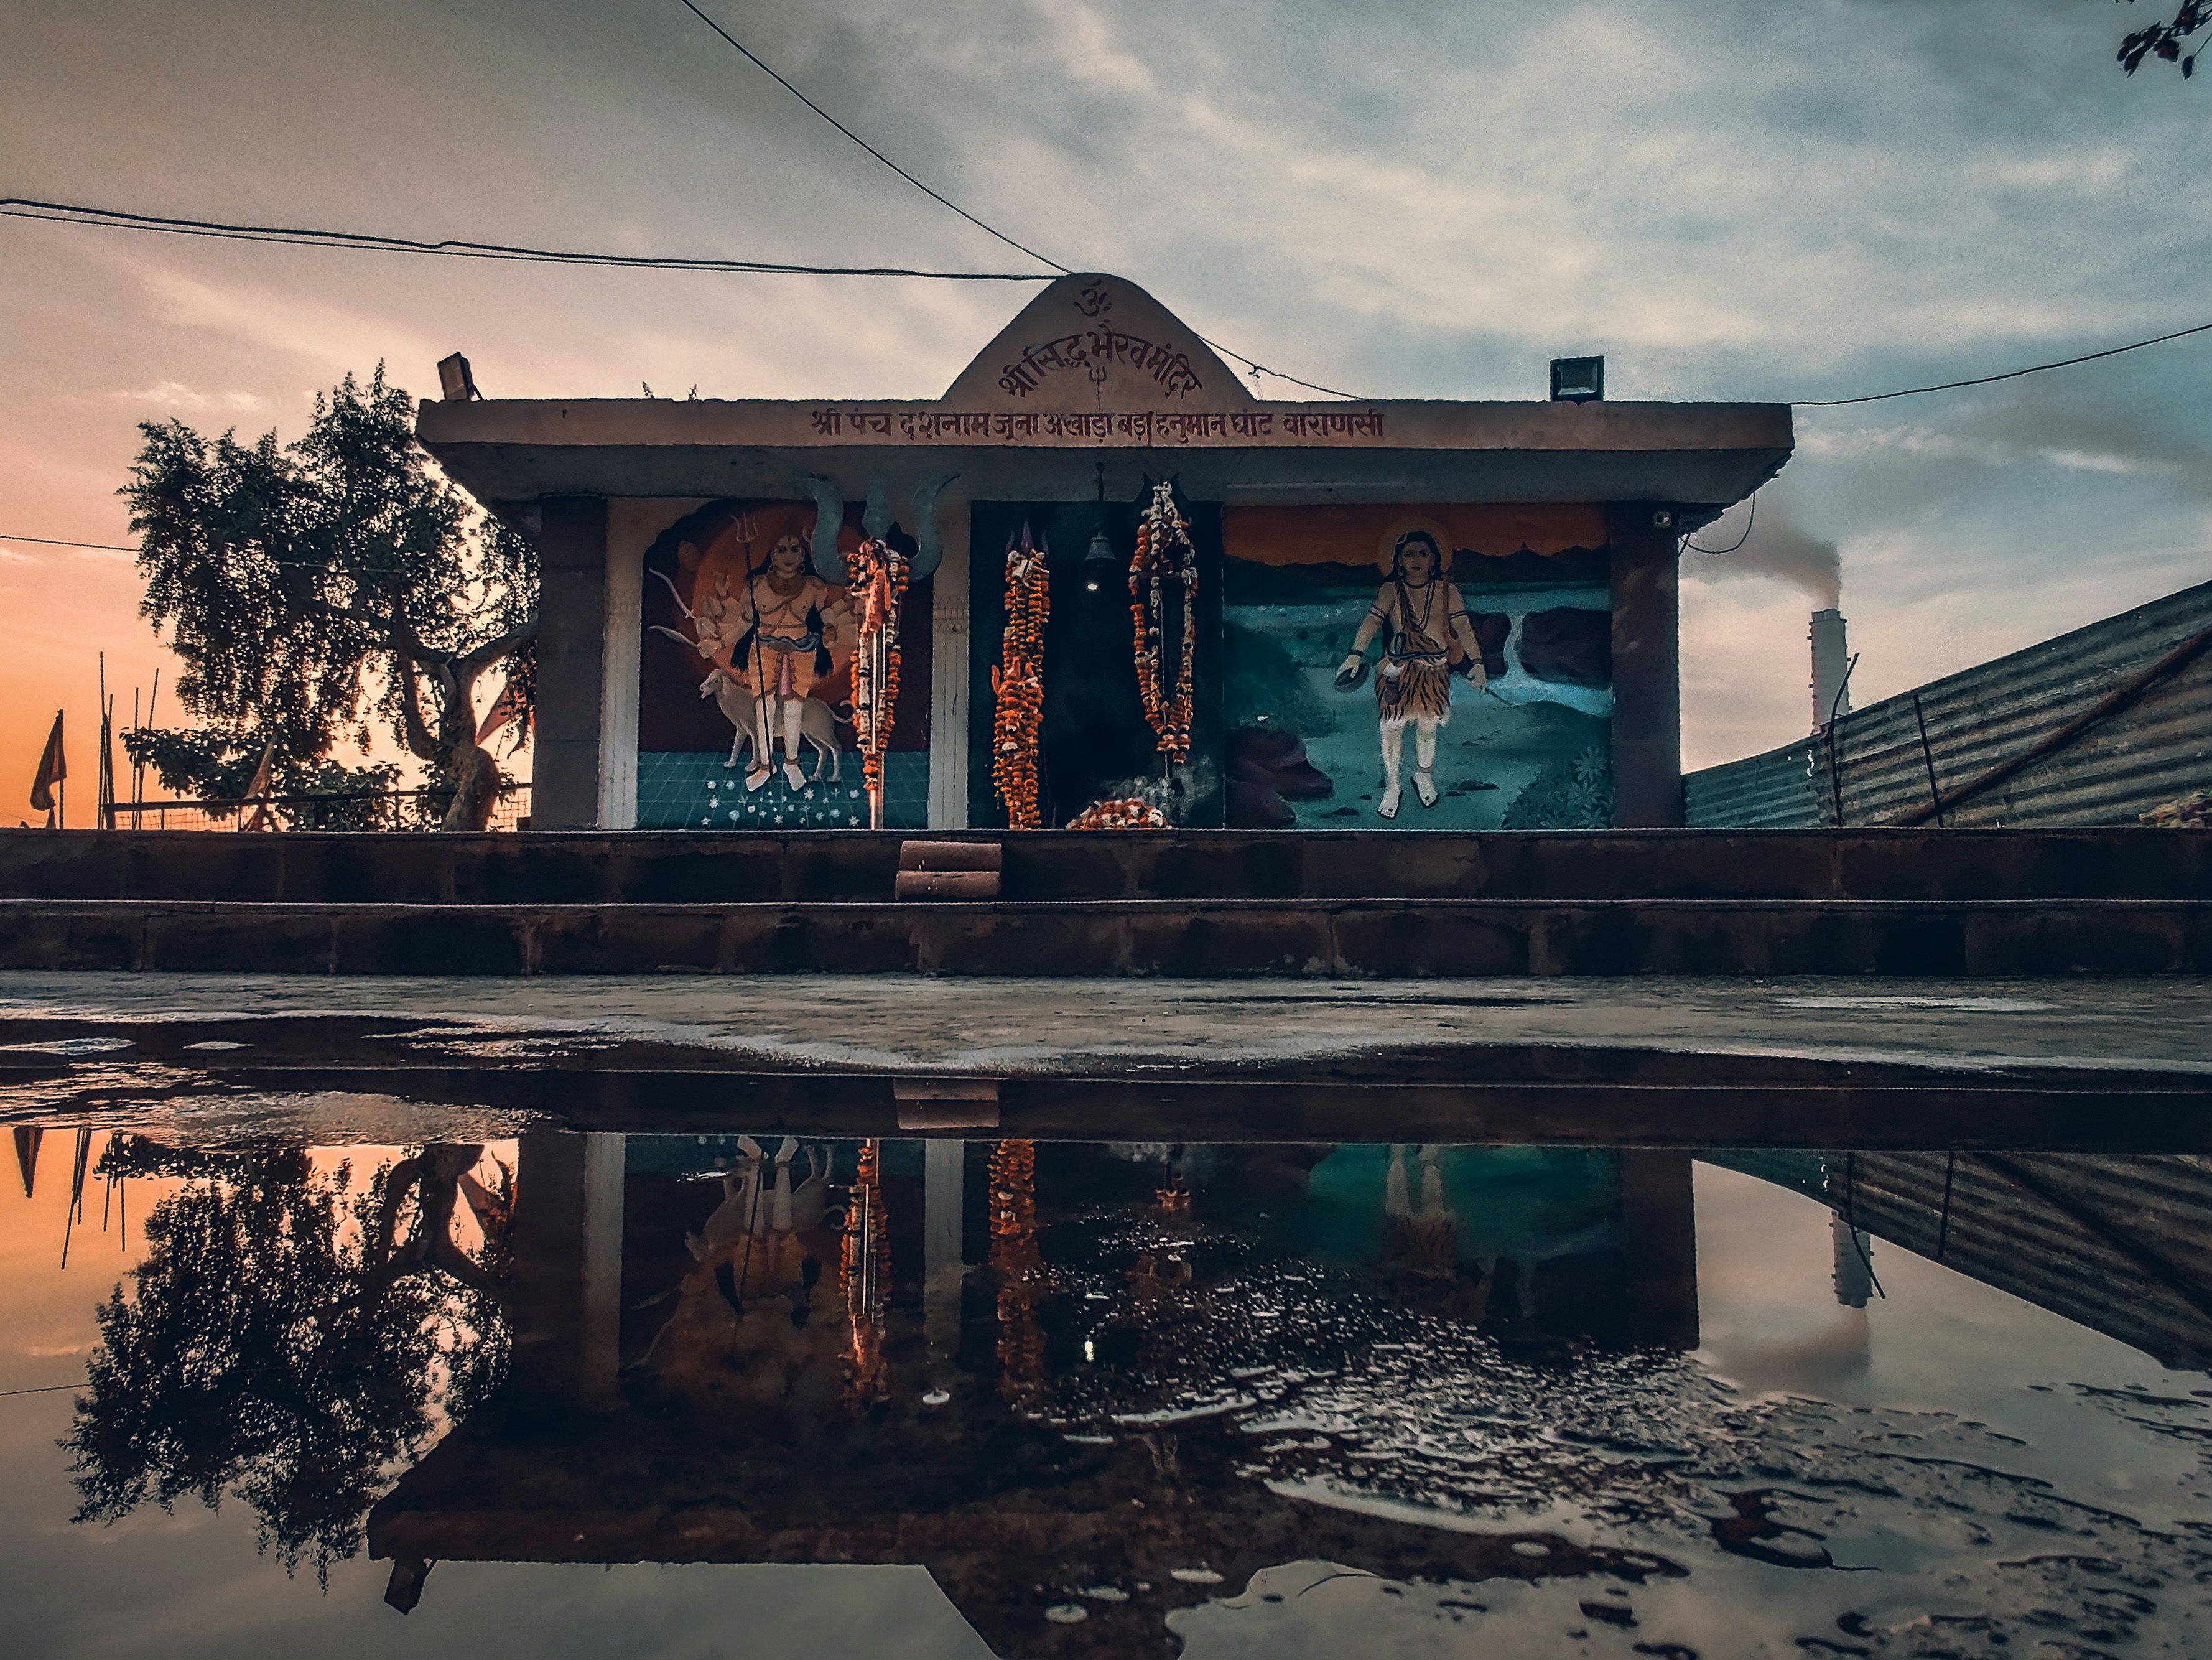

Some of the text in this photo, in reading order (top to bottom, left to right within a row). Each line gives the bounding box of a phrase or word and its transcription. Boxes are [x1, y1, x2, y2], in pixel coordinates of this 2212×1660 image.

[998, 364, 1038, 397] श्री
[1146, 343, 1203, 399] मंदिर
[811, 408, 841, 436] श्री
[845, 408, 893, 436] पंच
[993, 413, 1040, 441] जूना
[1118, 411, 1154, 441] बड़ा
[1155, 413, 1227, 444] हनुमान
[1283, 408, 1385, 437] वाराणसी
